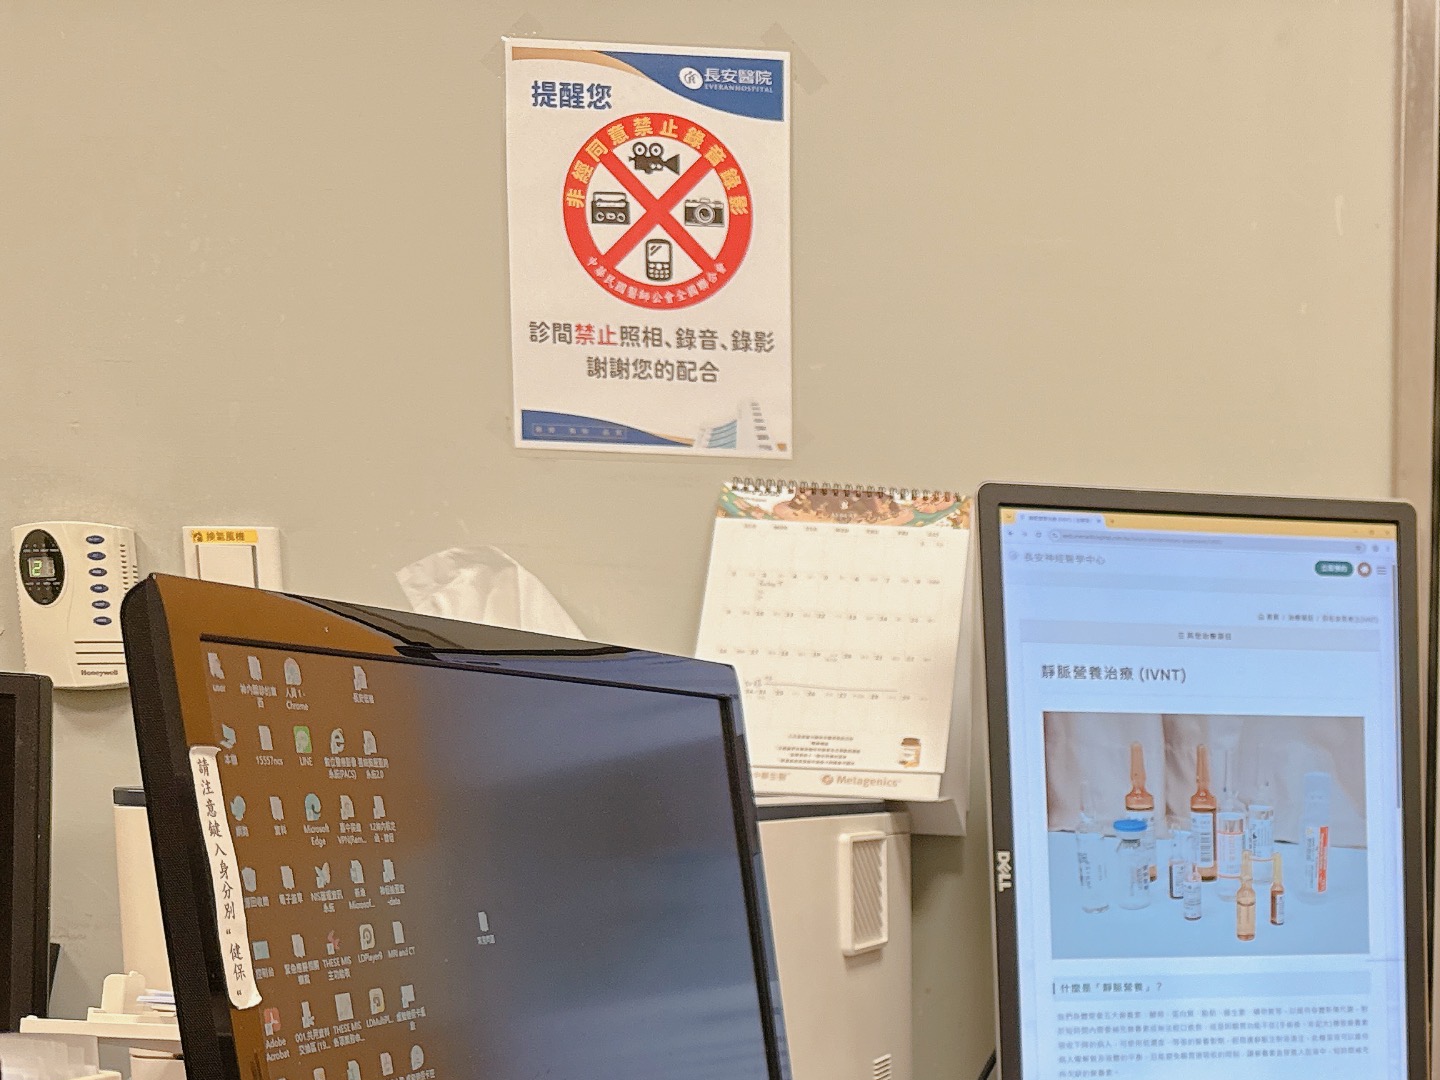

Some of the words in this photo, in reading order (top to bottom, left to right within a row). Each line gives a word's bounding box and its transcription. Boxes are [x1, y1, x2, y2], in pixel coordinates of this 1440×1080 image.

[704, 67, 773, 86] 長安醫院
[531, 80, 613, 110] 提醒您
[586, 356, 720, 383] 謝謝您的配合
[80, 669, 119, 677] Honeywell
[1041, 664, 1135, 682] 靜脈營養治療
[1138, 668, 1187, 684] (IVNT)
[836, 775, 899, 788] Metagenics
[996, 850, 1012, 892] DELL
[264, 1037, 287, 1049] Adobe
[265, 1049, 290, 1062] Acrobat
